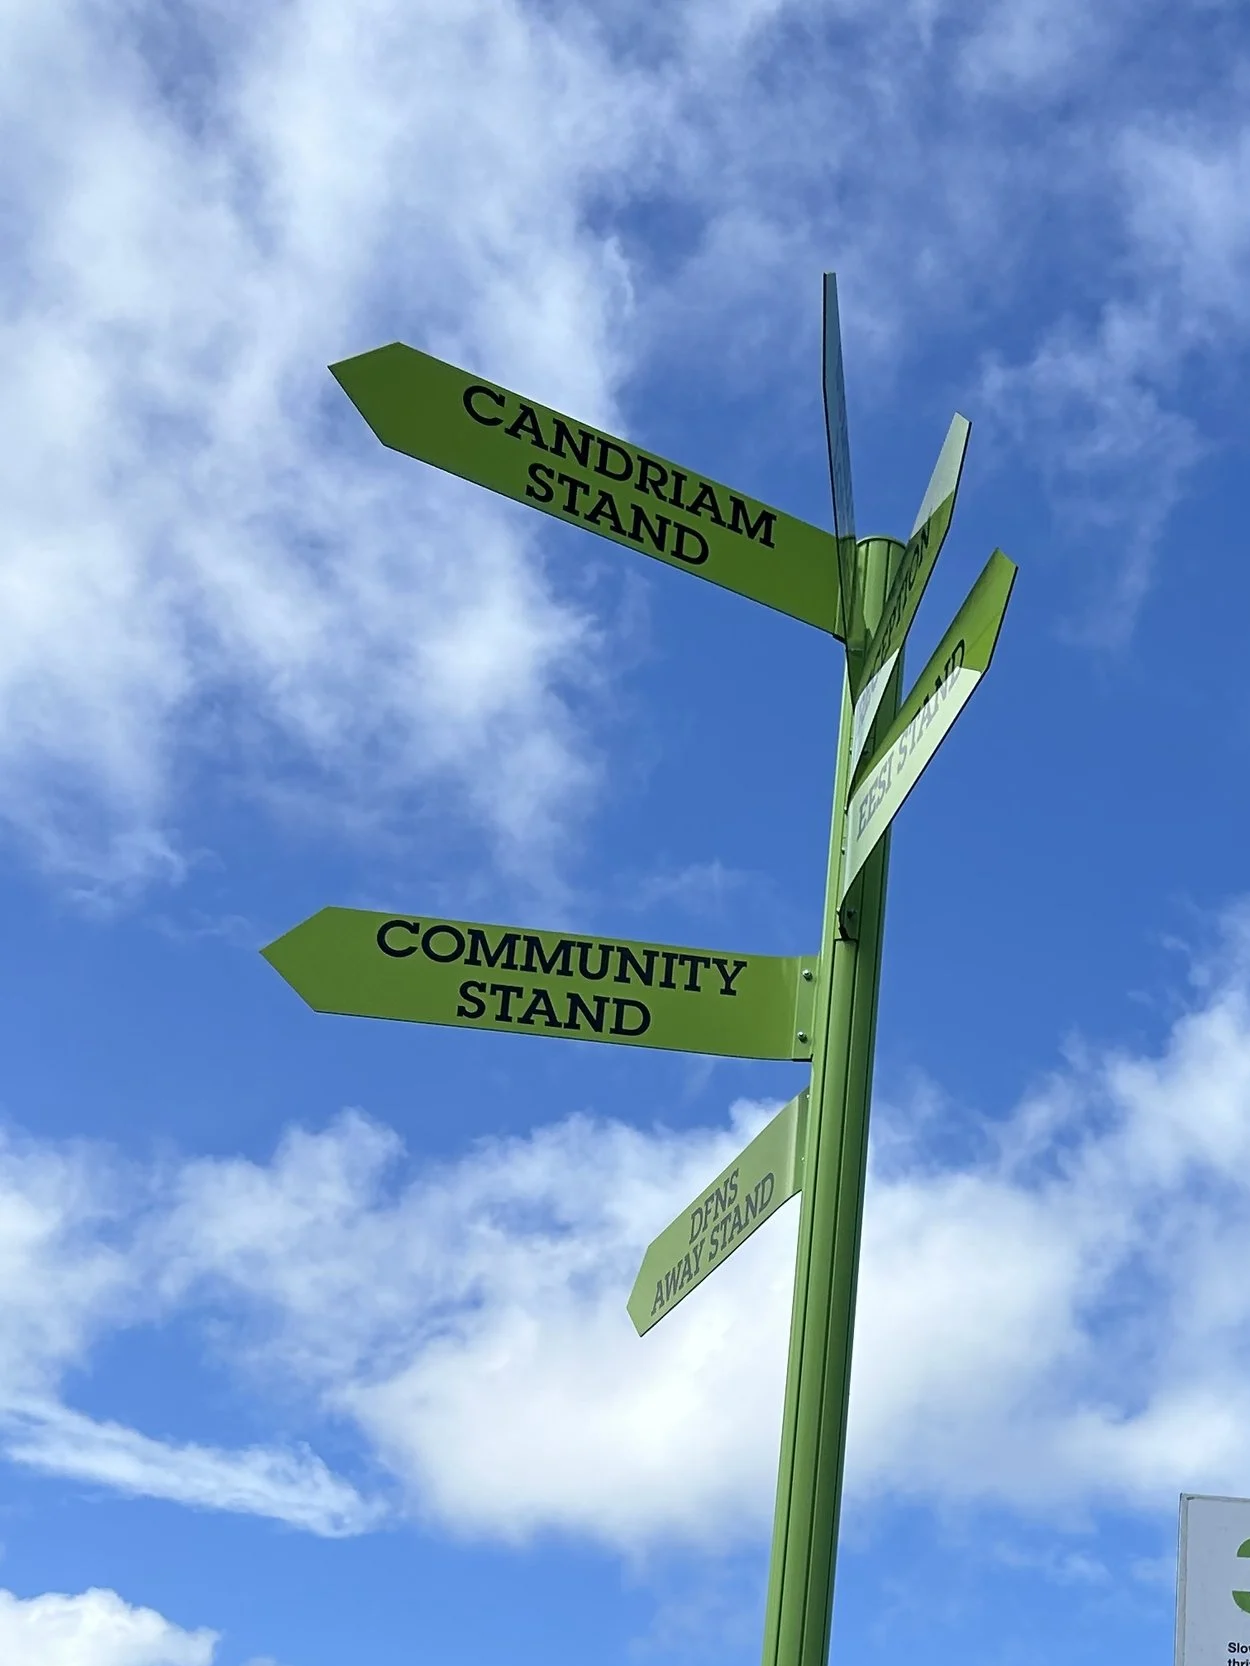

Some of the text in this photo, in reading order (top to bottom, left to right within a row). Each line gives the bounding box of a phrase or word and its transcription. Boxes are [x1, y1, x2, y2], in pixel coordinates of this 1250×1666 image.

[462, 385, 777, 548] CANDRIAM
[525, 463, 709, 566] STAND
[855, 637, 966, 841] EESI STAND
[376, 919, 748, 998] COMMUNITY
[456, 982, 651, 1037] STAND
[651, 1172, 775, 1316] AWAY STAND
[689, 1168, 740, 1244] DFNS
